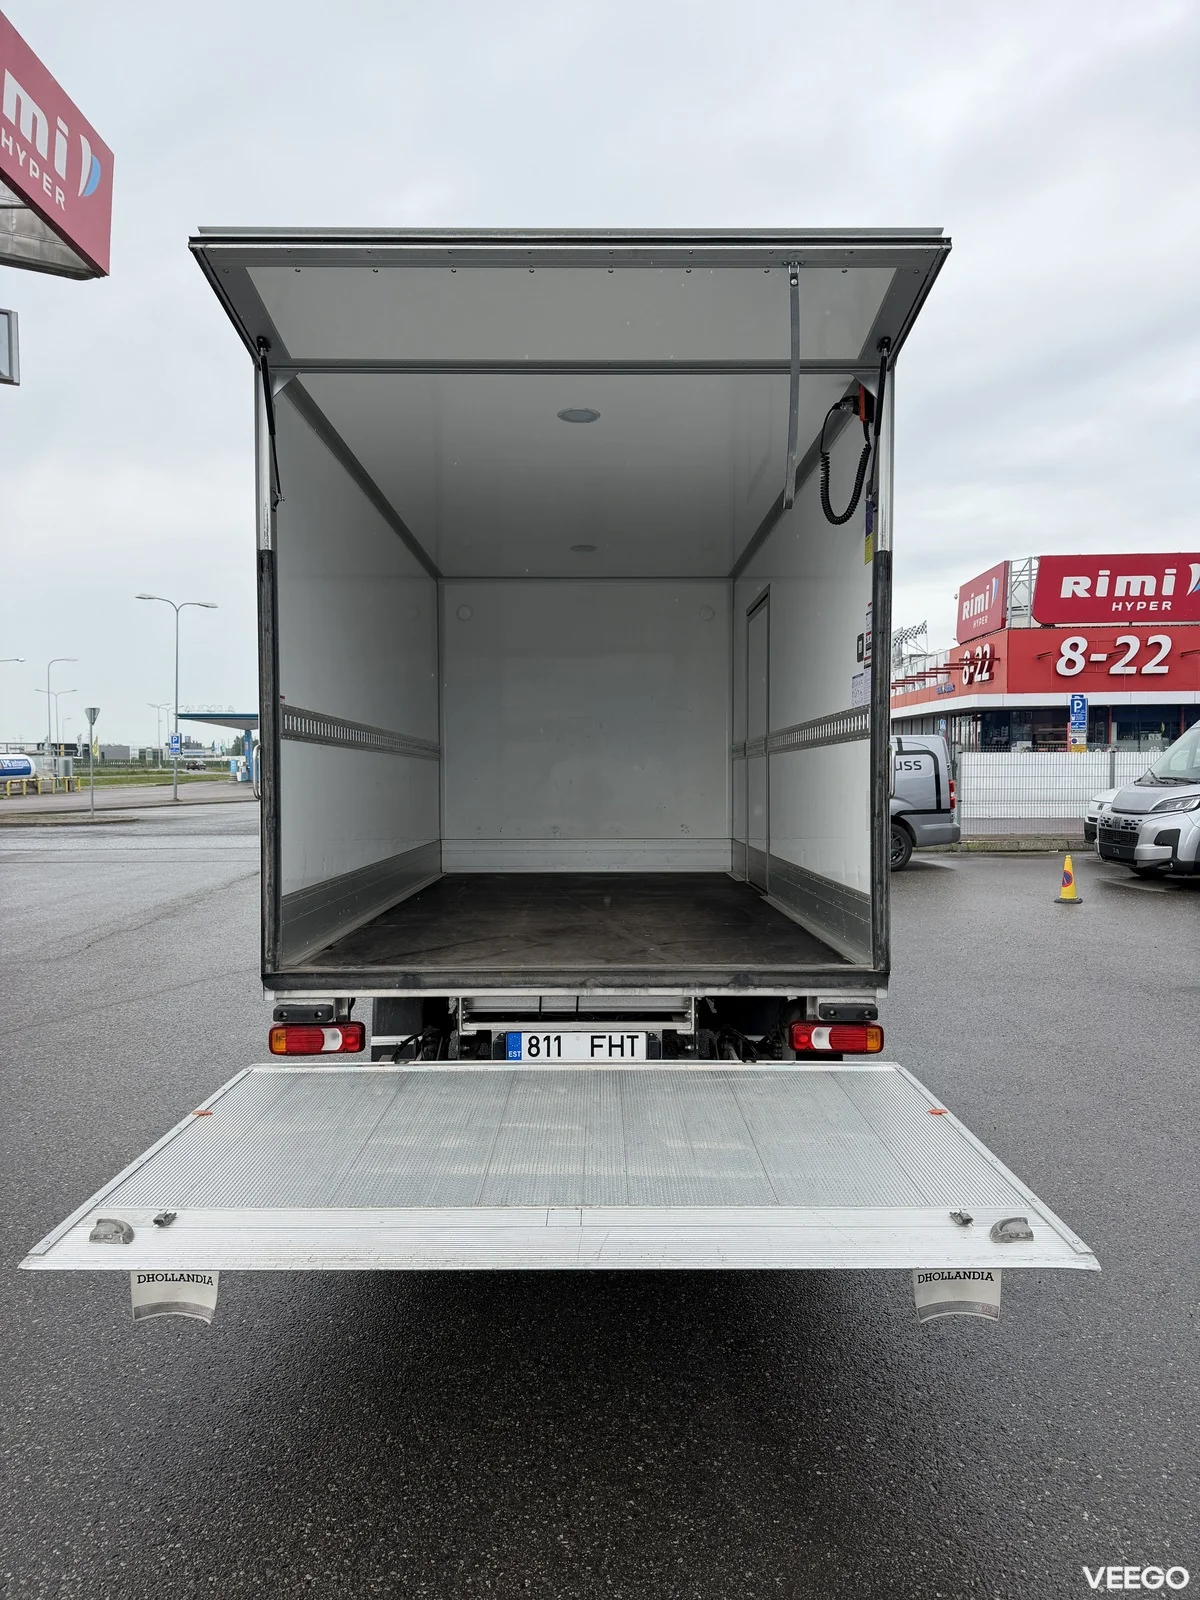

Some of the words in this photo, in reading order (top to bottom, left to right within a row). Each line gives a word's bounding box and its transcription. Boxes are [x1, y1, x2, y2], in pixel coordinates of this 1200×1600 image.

[1, 126, 66, 211] HYPER
[1060, 569, 1177, 598] Rimi
[962, 584, 990, 621] Rimi
[1111, 601, 1172, 611] HYPER
[972, 615, 989, 629] HYPER
[962, 643, 991, 686] 8-22
[1056, 635, 1172, 676] 8-22
[1074, 700, 1083, 713] P
[508, 1050, 522, 1058] EST
[527, 1035, 562, 1058] 811
[590, 1035, 639, 1058] FHT
[136, 1273, 214, 1286] DHOLLANDIA
[917, 1271, 995, 1284] DHOLLANDIA
